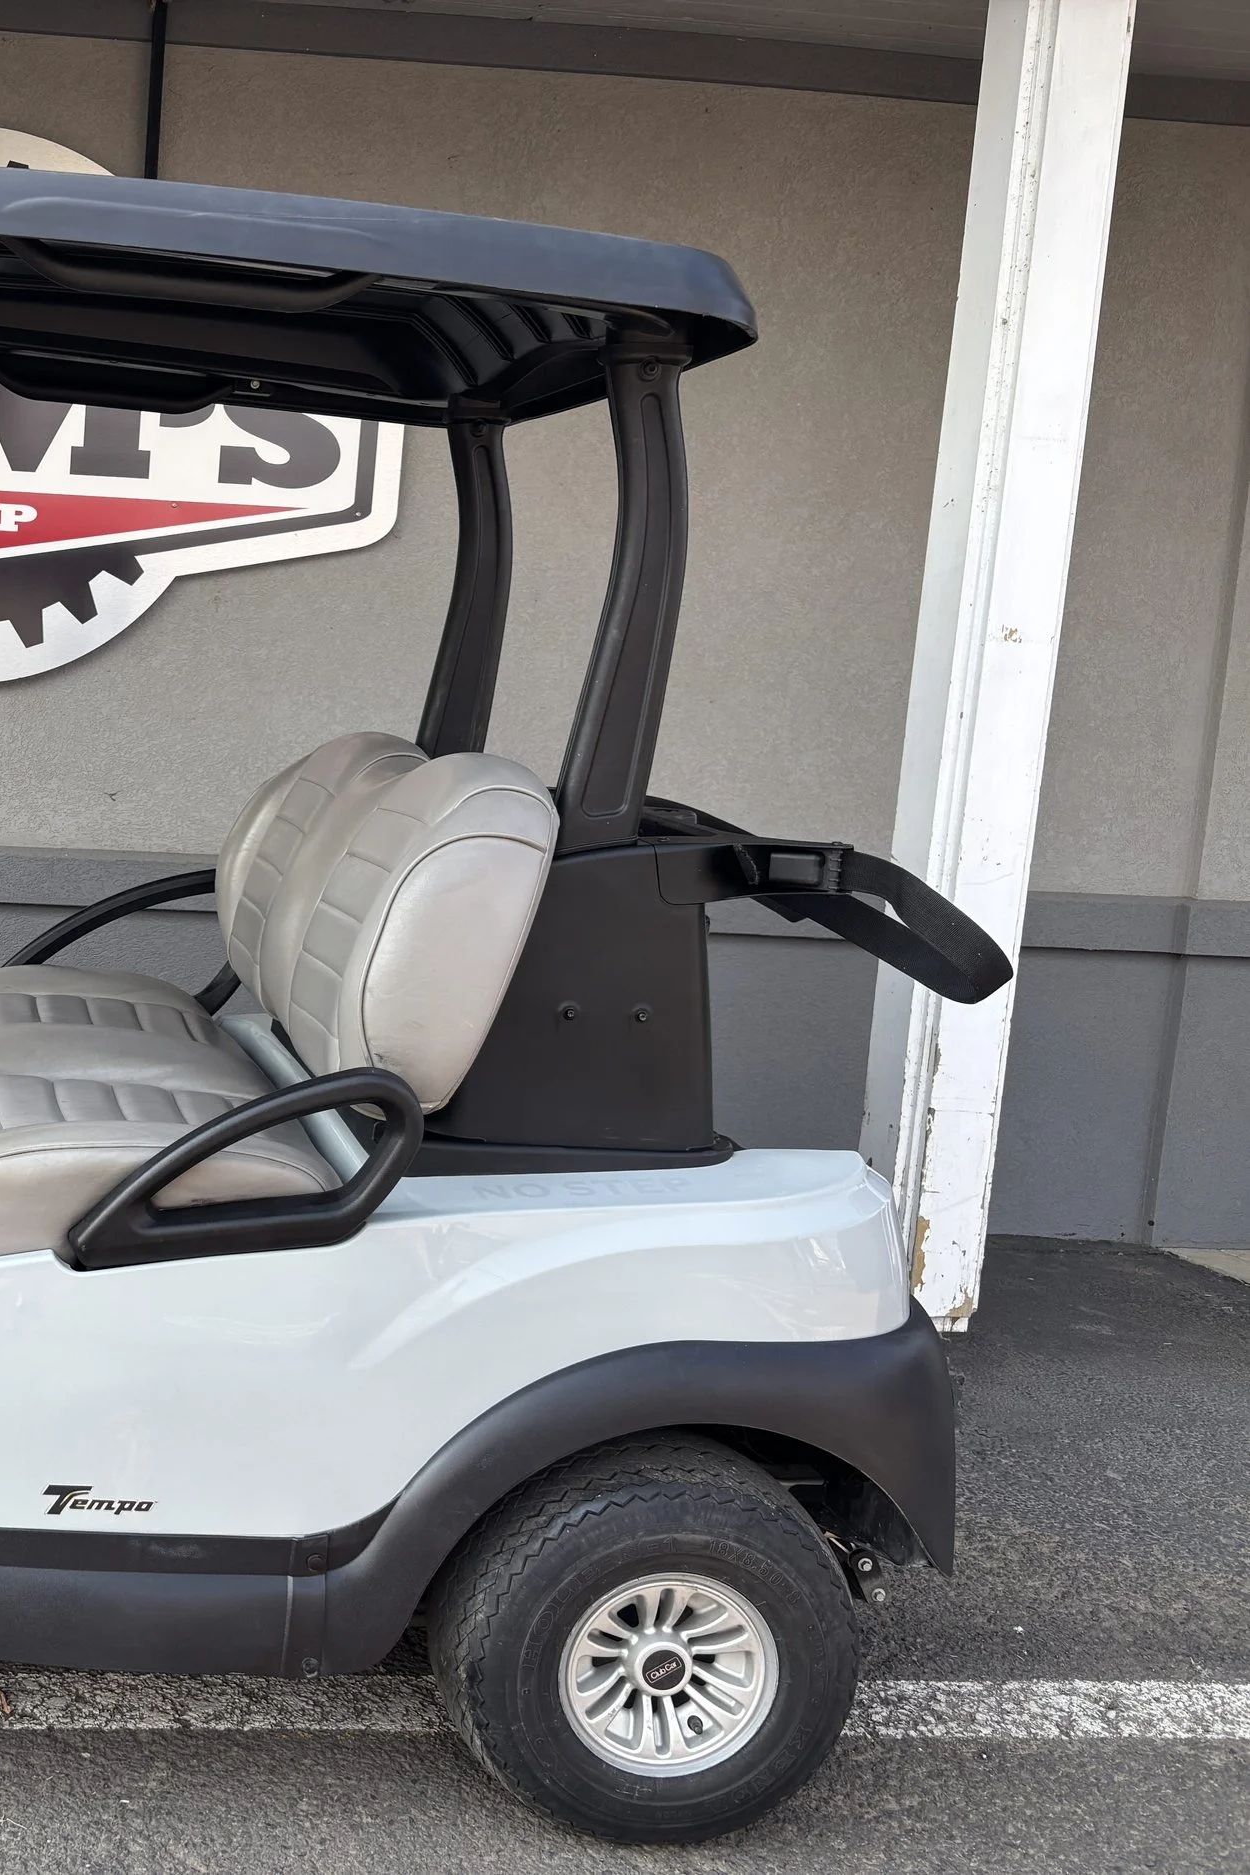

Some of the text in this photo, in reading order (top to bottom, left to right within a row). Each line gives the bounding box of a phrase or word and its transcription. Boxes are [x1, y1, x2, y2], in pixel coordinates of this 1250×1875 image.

[472, 1177, 691, 1201] NO STEP
[42, 1484, 155, 1515] Tempo
[650, 1661, 678, 1680] Club Car
